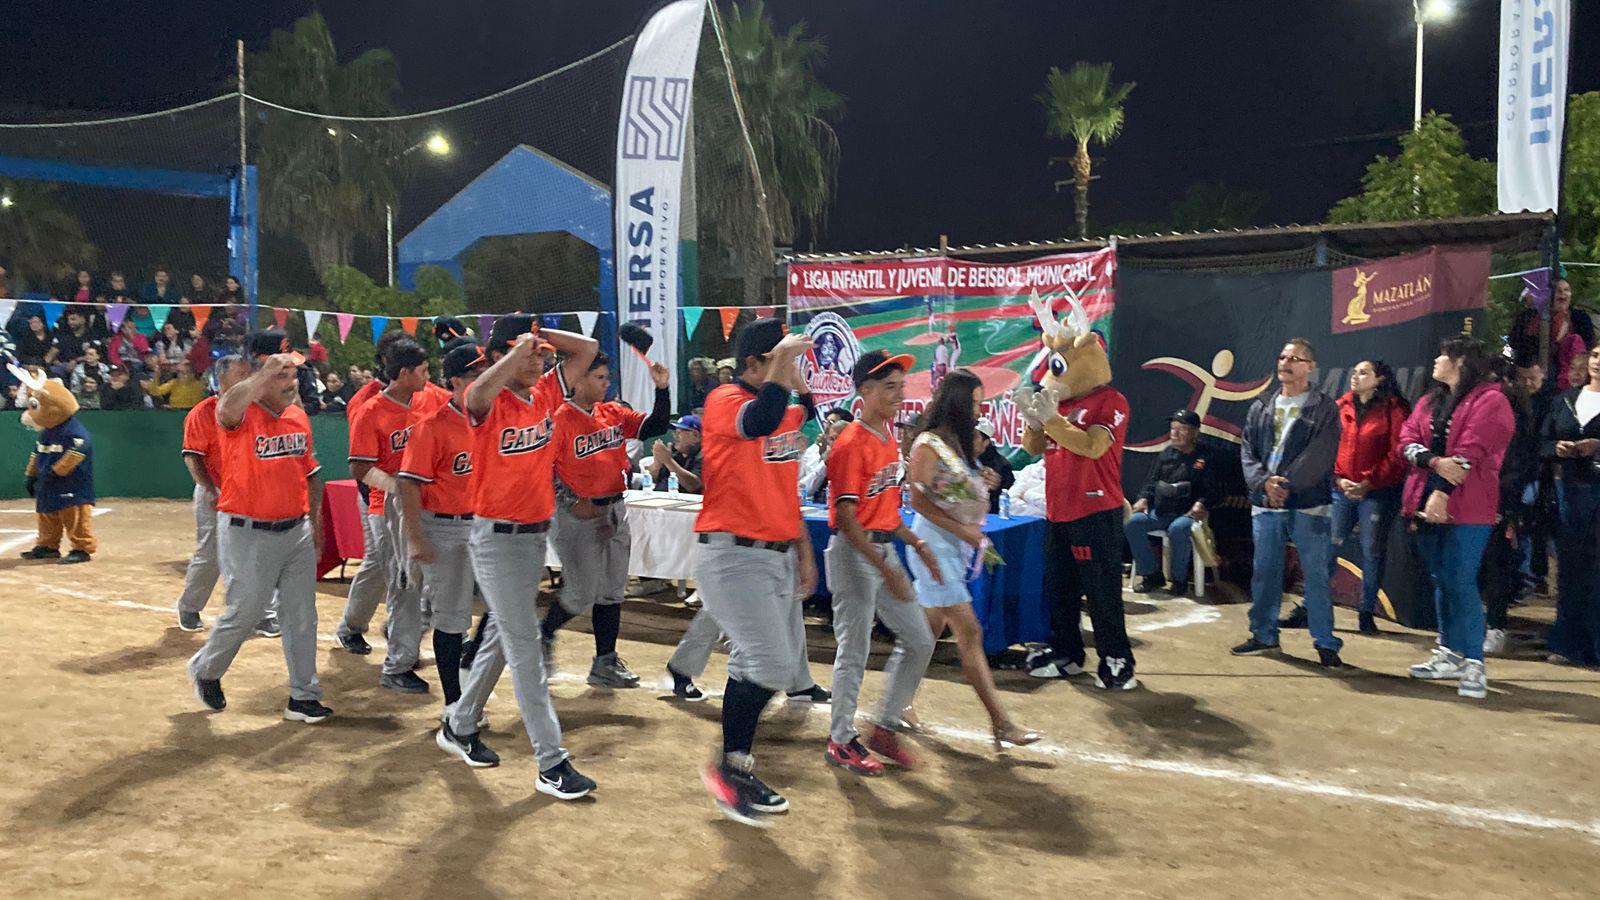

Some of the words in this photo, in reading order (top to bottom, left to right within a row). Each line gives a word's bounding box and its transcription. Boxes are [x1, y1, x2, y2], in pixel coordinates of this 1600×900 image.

[659, 201, 669, 326] CORPORATIVO
[803, 270, 830, 290] LIGA
[831, 269, 886, 289] INFANTIL
[888, 268, 897, 288] Y
[896, 266, 945, 294] JUVENIL
[947, 267, 966, 287] DE
[968, 266, 1025, 288] BEISBOL
[1026, 261, 1096, 287] MUNICIPAL
